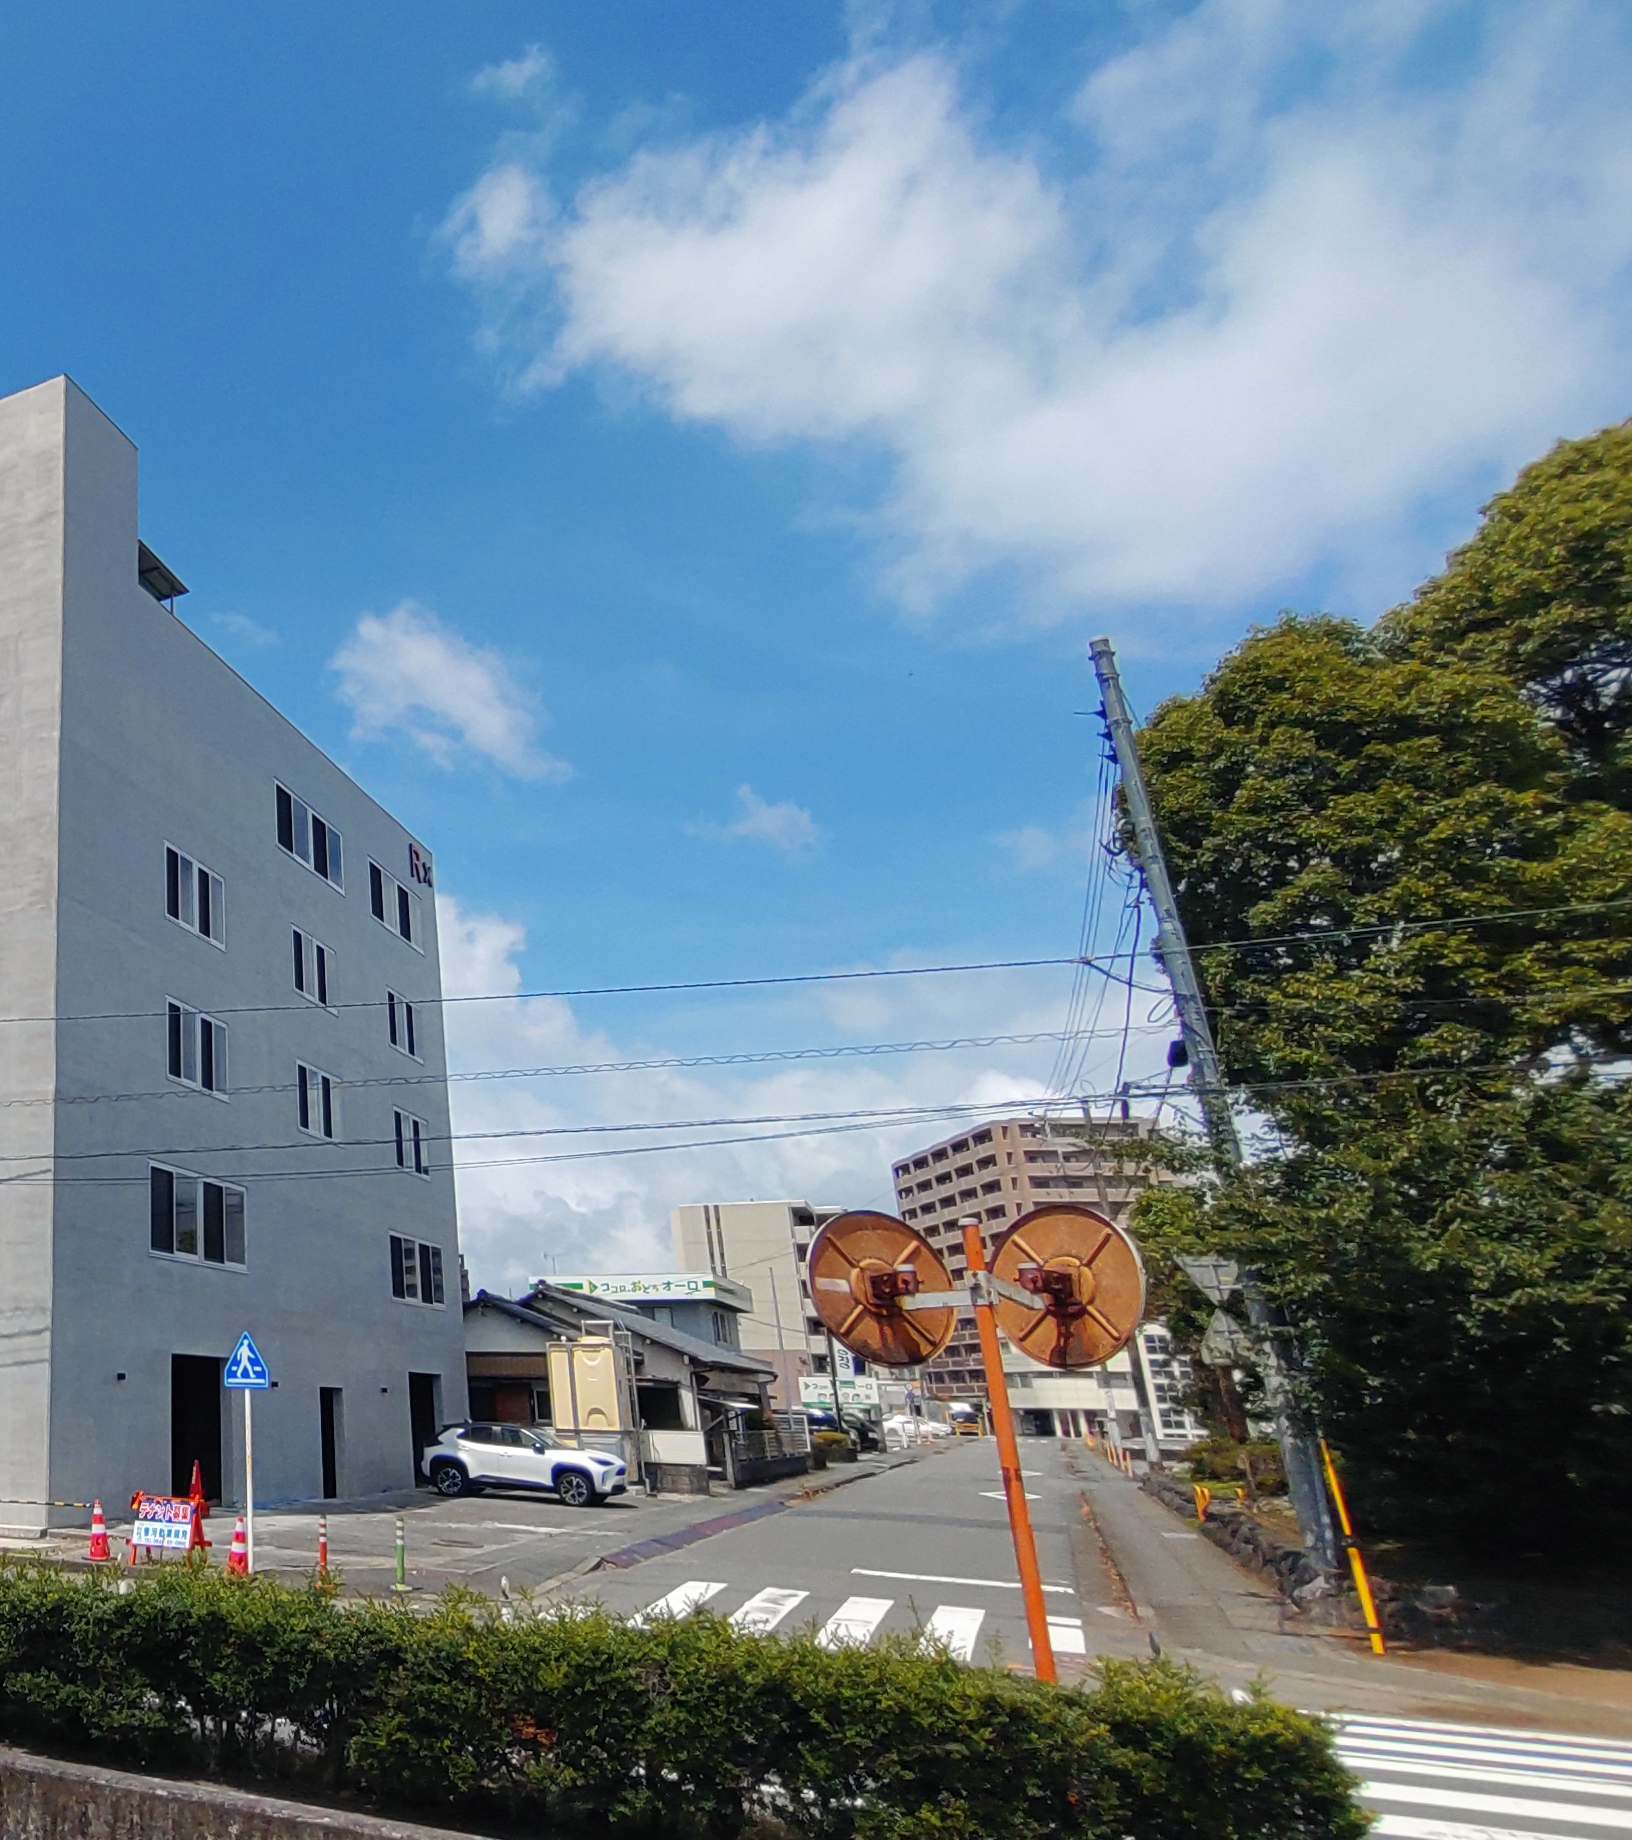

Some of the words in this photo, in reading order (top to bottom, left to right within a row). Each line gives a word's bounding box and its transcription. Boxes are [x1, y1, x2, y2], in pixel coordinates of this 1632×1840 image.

[139, 1503, 190, 1522] テナント募集
